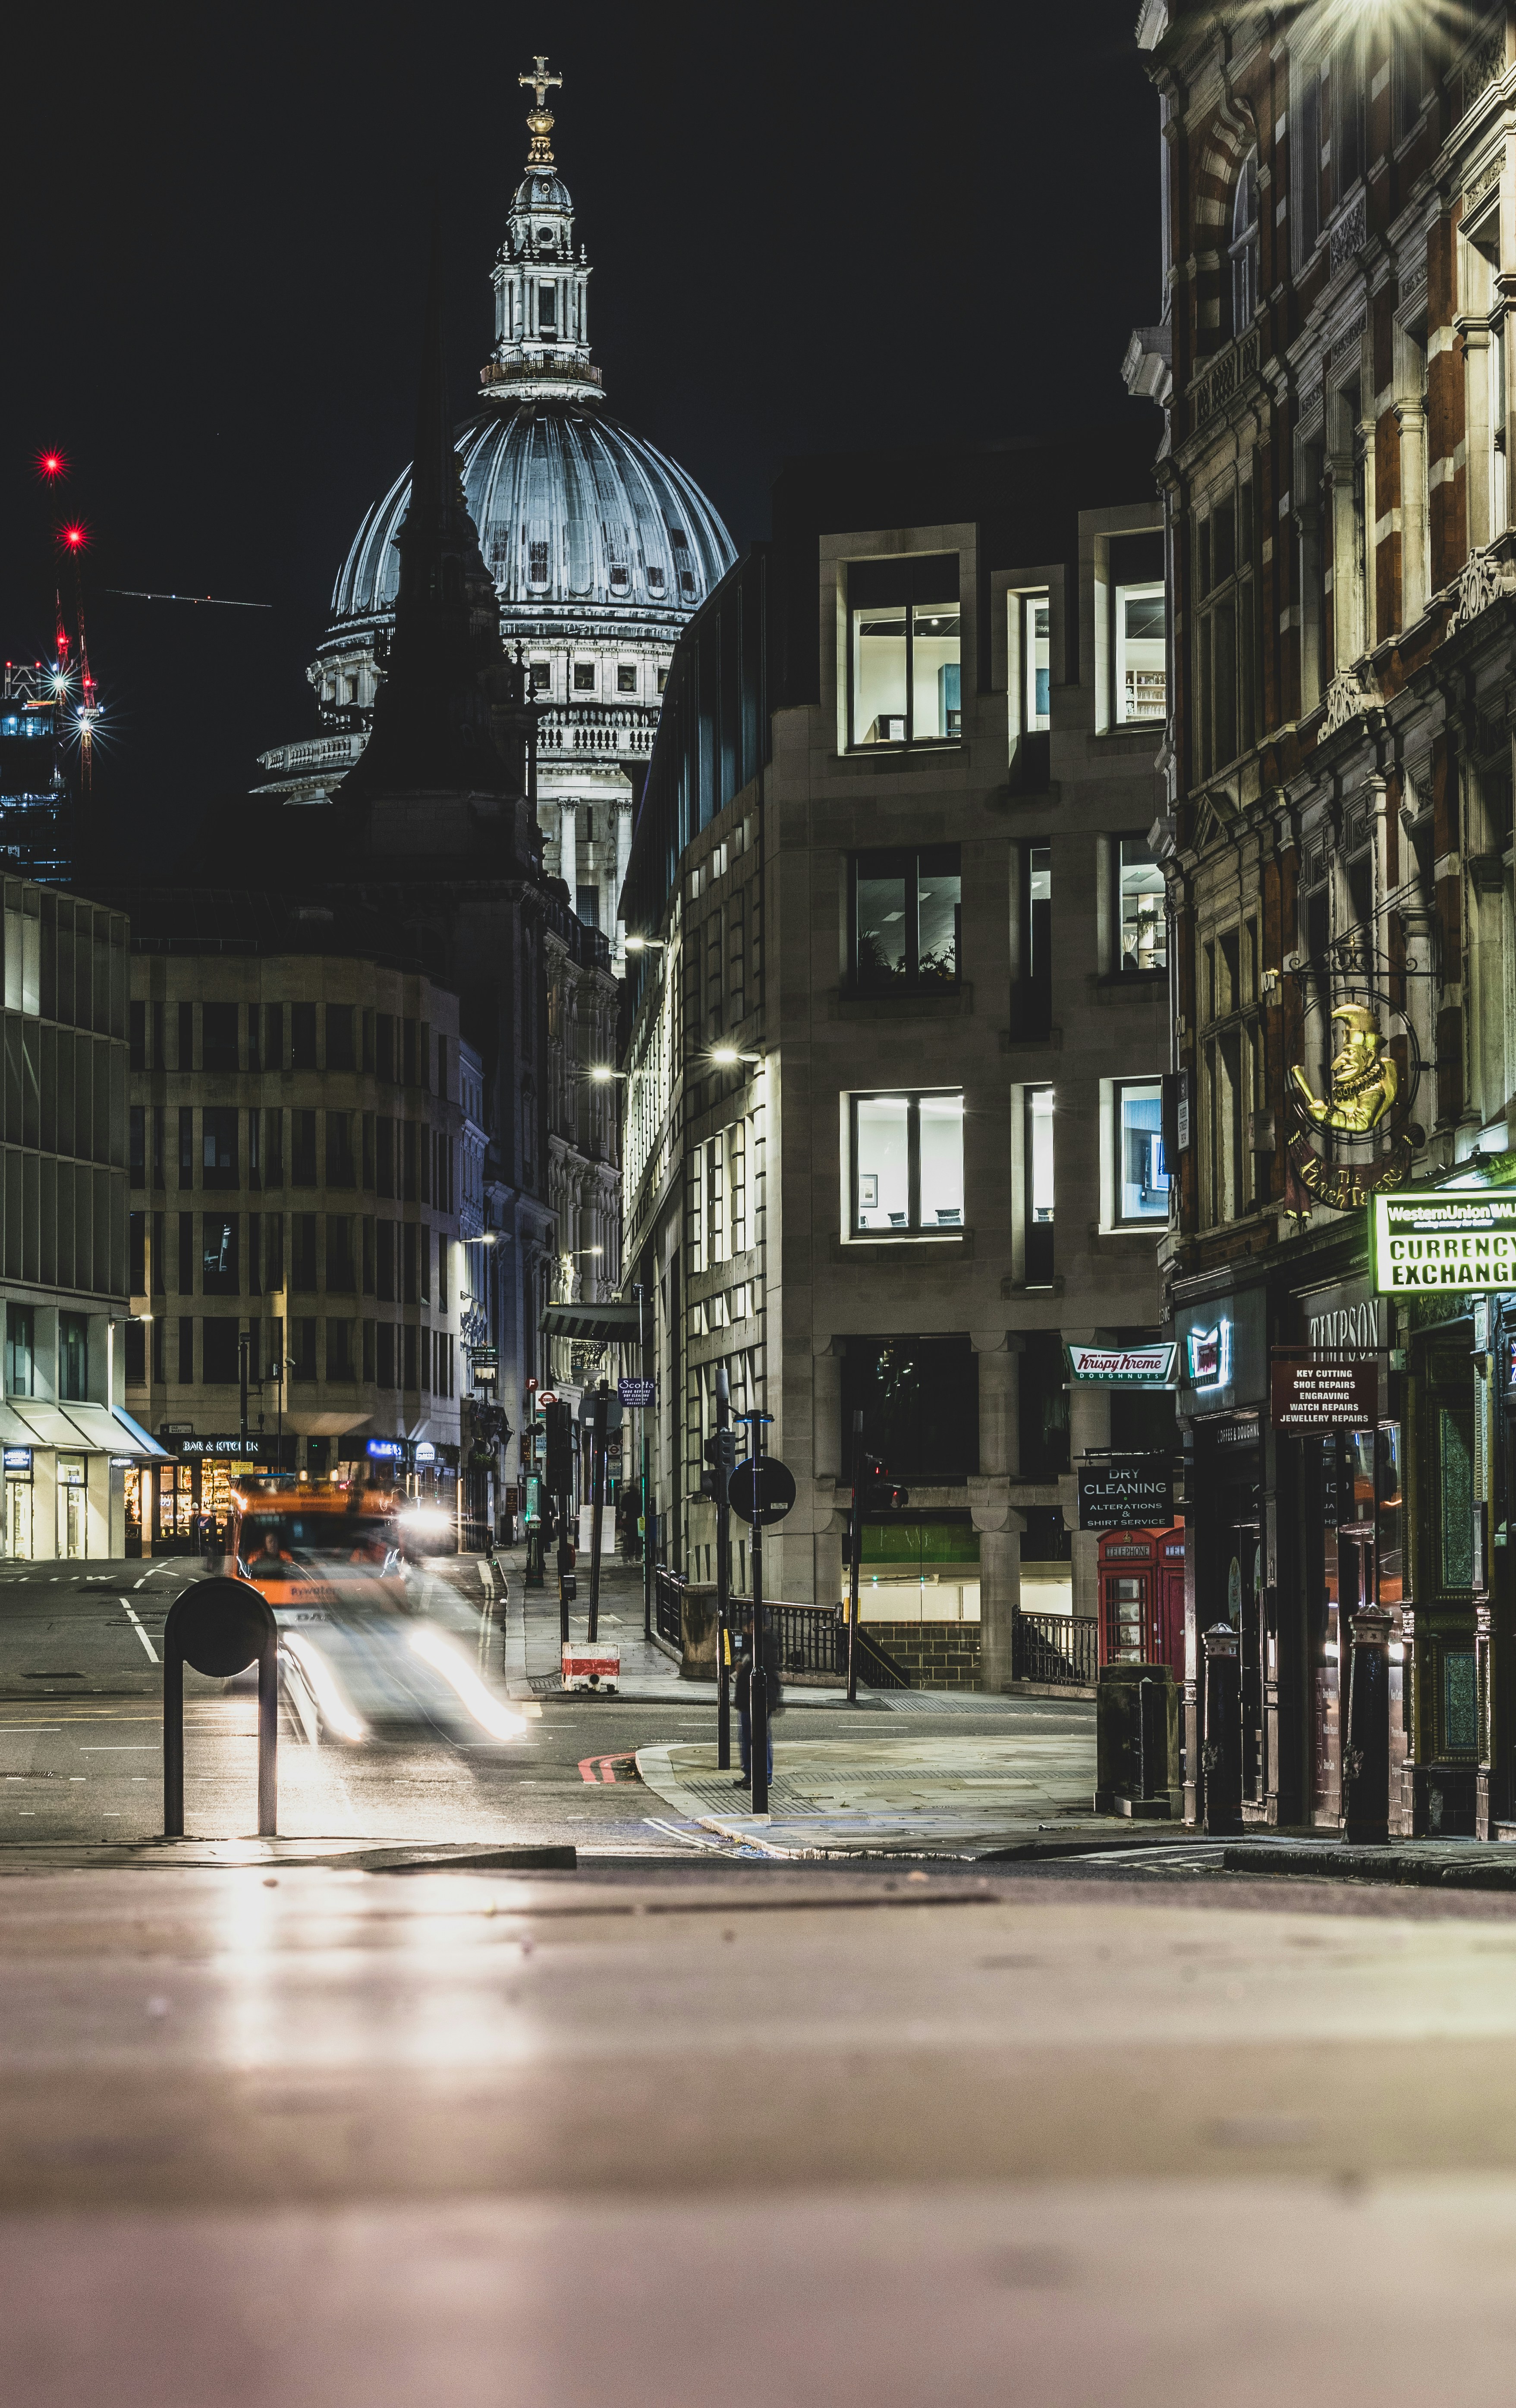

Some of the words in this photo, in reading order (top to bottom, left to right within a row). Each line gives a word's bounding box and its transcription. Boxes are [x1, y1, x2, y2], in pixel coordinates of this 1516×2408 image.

[1310, 1299, 1378, 1362] TIMPSON
[1078, 1353, 1122, 1372] Krispy
[1119, 1353, 1164, 1370] Kreme
[529, 1379, 535, 1388] F
[619, 1380, 654, 1389] Scotts
[1233, 1427, 1236, 1441] &
[183, 1441, 204, 1451] BAR
[205, 1441, 213, 1451] &
[216, 1441, 258, 1451] KITCEN
[1109, 1469, 1140, 1479] DRY
[1084, 1483, 1167, 1494] CLEANING
[1107, 1547, 1149, 1557] TELEPHONE
[1167, 1545, 1185, 1556] TEL
